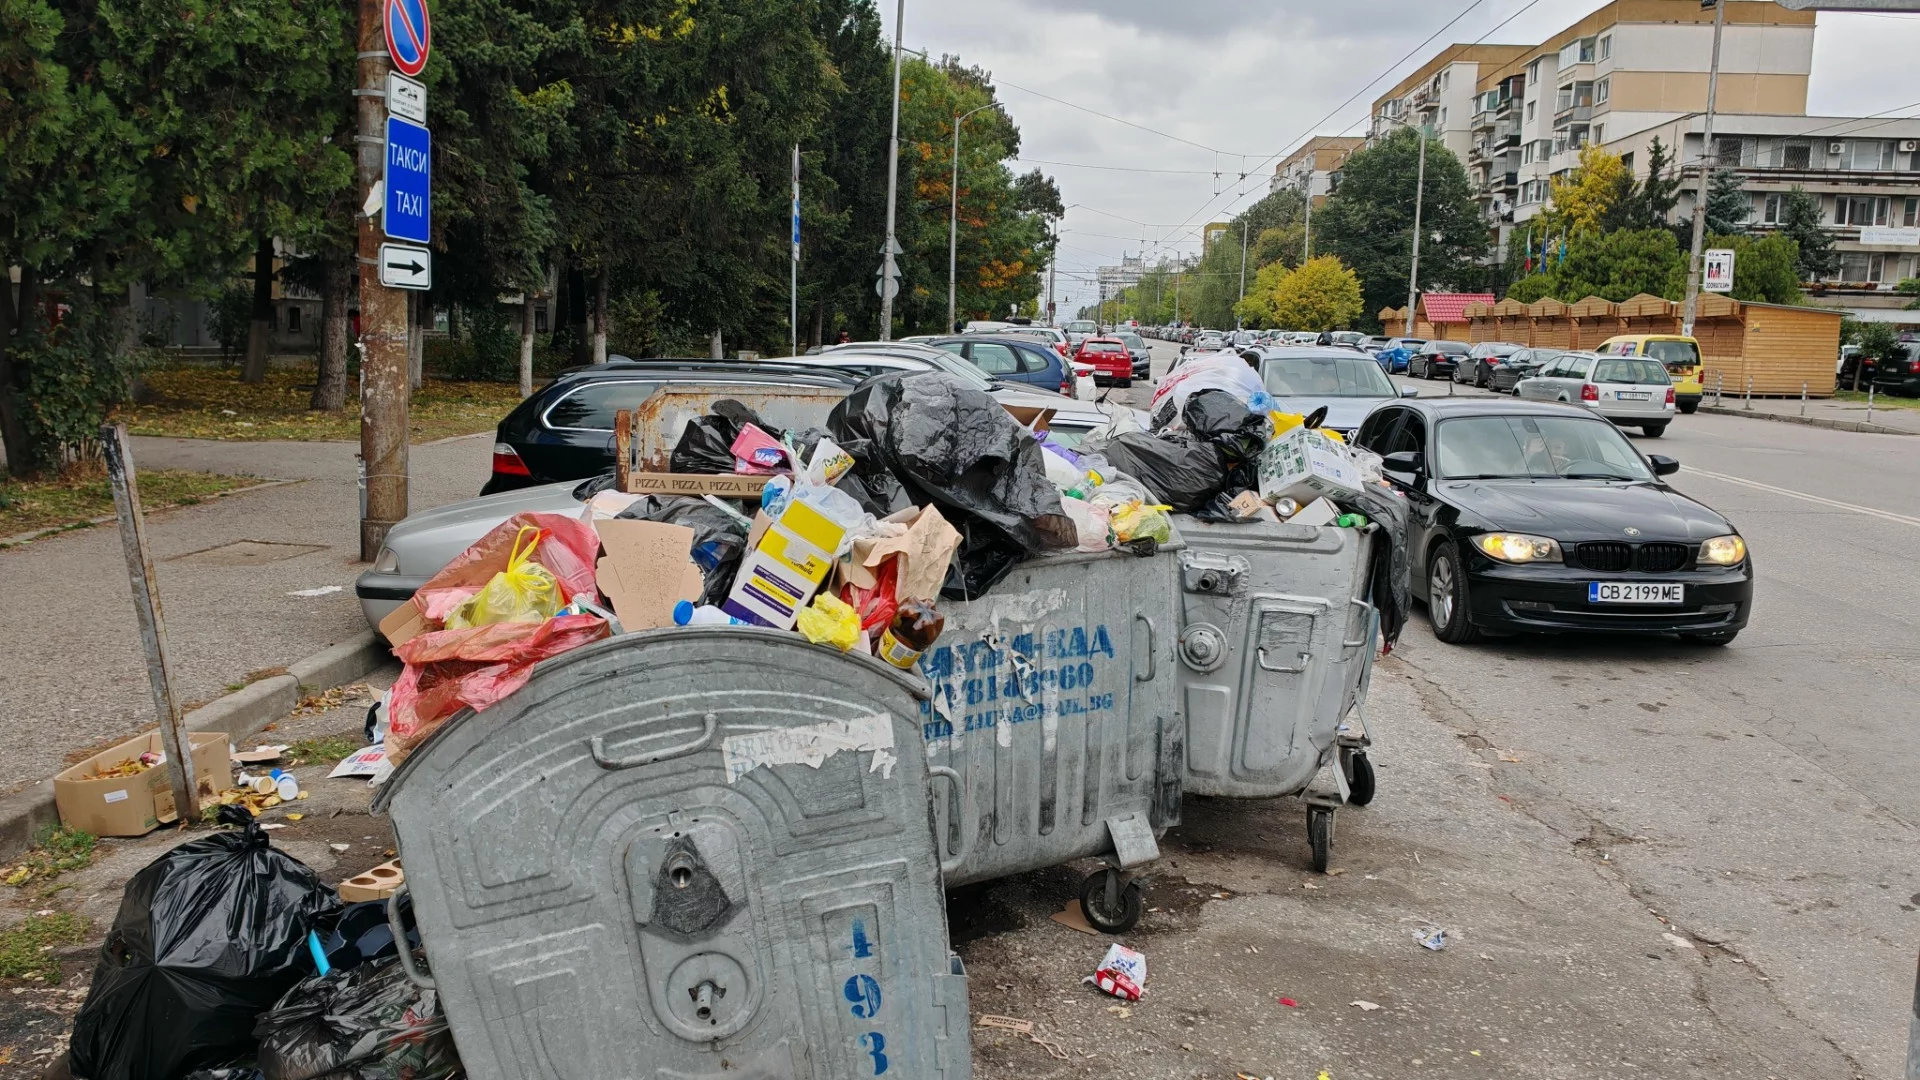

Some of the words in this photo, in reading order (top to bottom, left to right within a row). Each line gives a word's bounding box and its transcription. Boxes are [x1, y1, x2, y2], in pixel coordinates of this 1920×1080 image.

[390, 142, 427, 174] ТАКСИ
[396, 190, 422, 217] TAXI
[635, 478, 667, 489] PIZZA
[672, 480, 704, 490] PIZZA
[709, 481, 741, 492] PIZZA
[747, 482, 765, 492] PIZ
[1600, 585, 1620, 600] CB
[1623, 585, 1660, 600] 2199
[1661, 586, 1681, 600] ME
